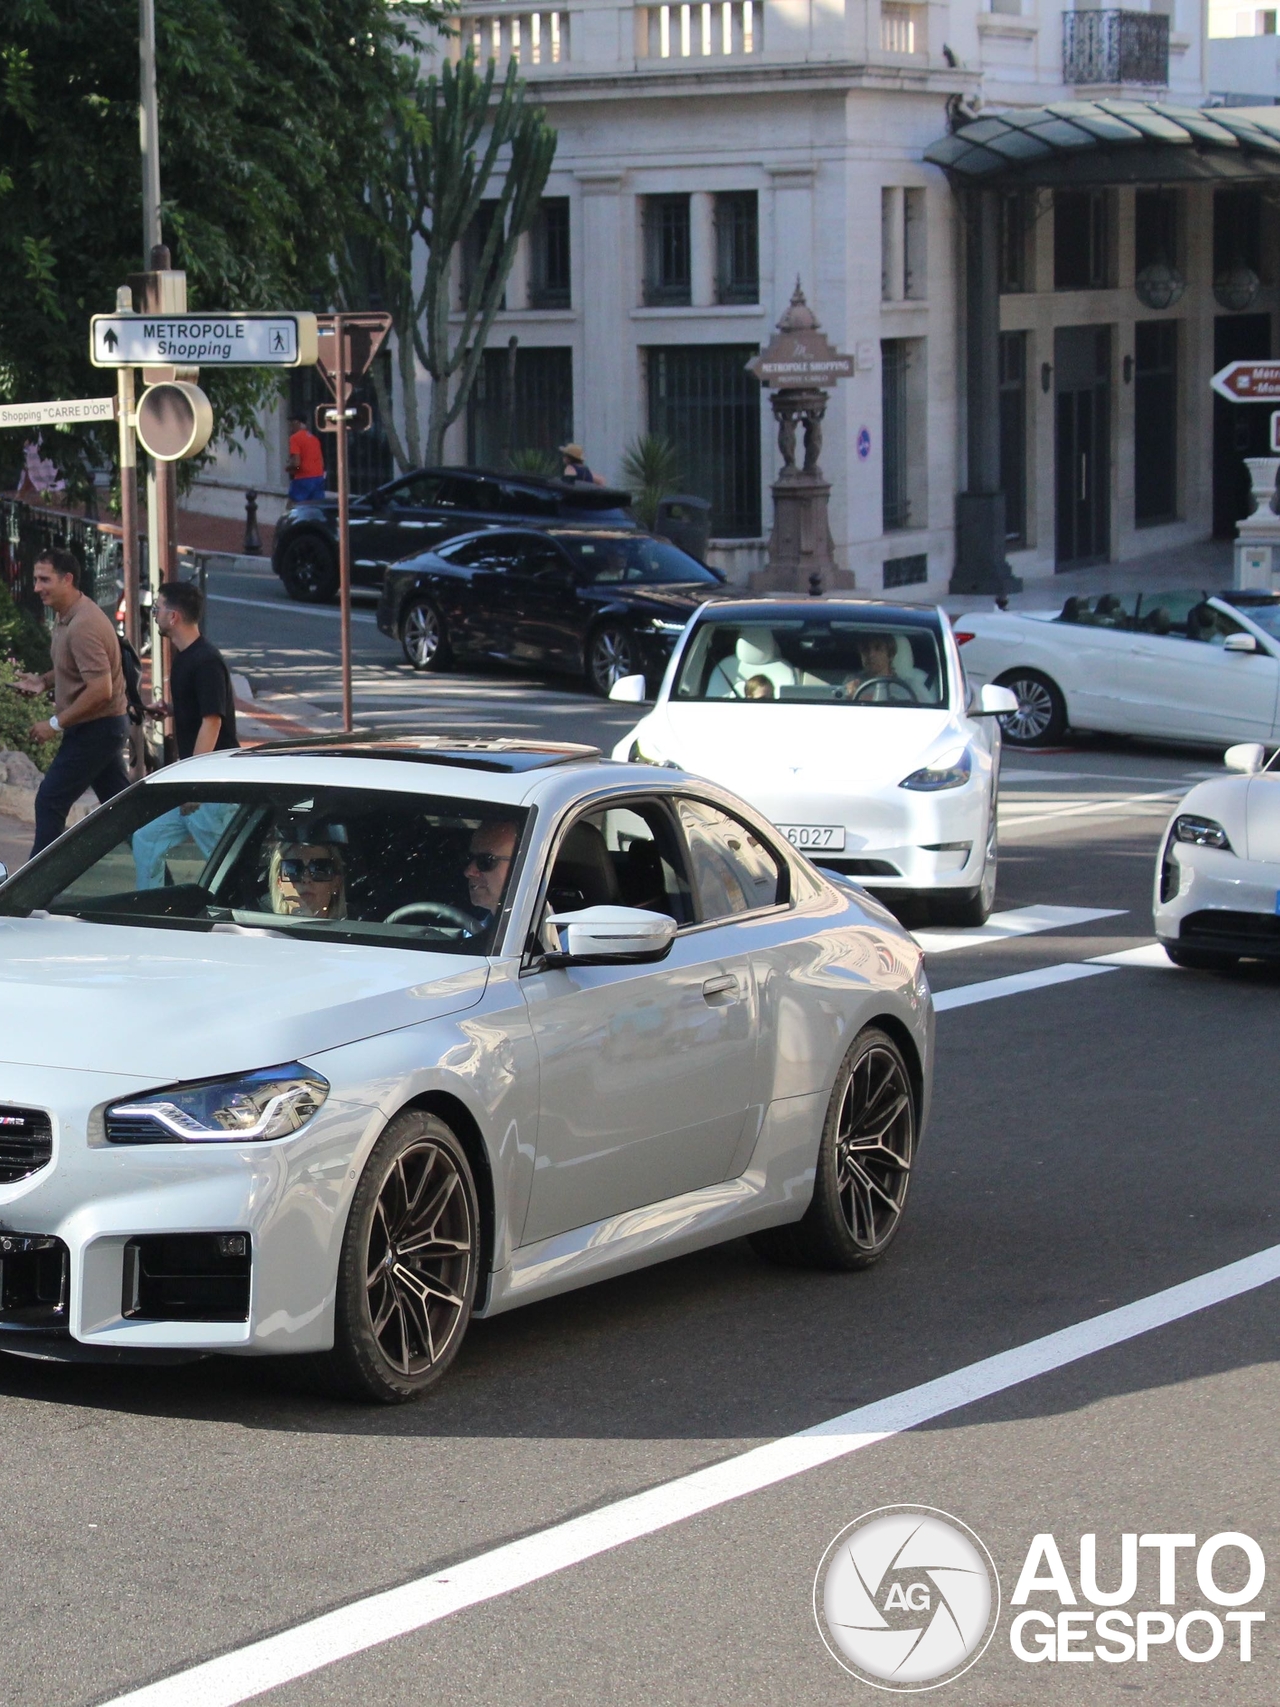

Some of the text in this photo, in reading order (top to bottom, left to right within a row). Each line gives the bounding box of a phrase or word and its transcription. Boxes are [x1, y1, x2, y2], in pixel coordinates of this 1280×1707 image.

[144, 324, 244, 338] METROPOLE
[157, 341, 232, 358] Shopping
[762, 361, 849, 372] METROPOLE SHOPPING
[1, 404, 110, 422] Shopping "CARRE D'OR"
